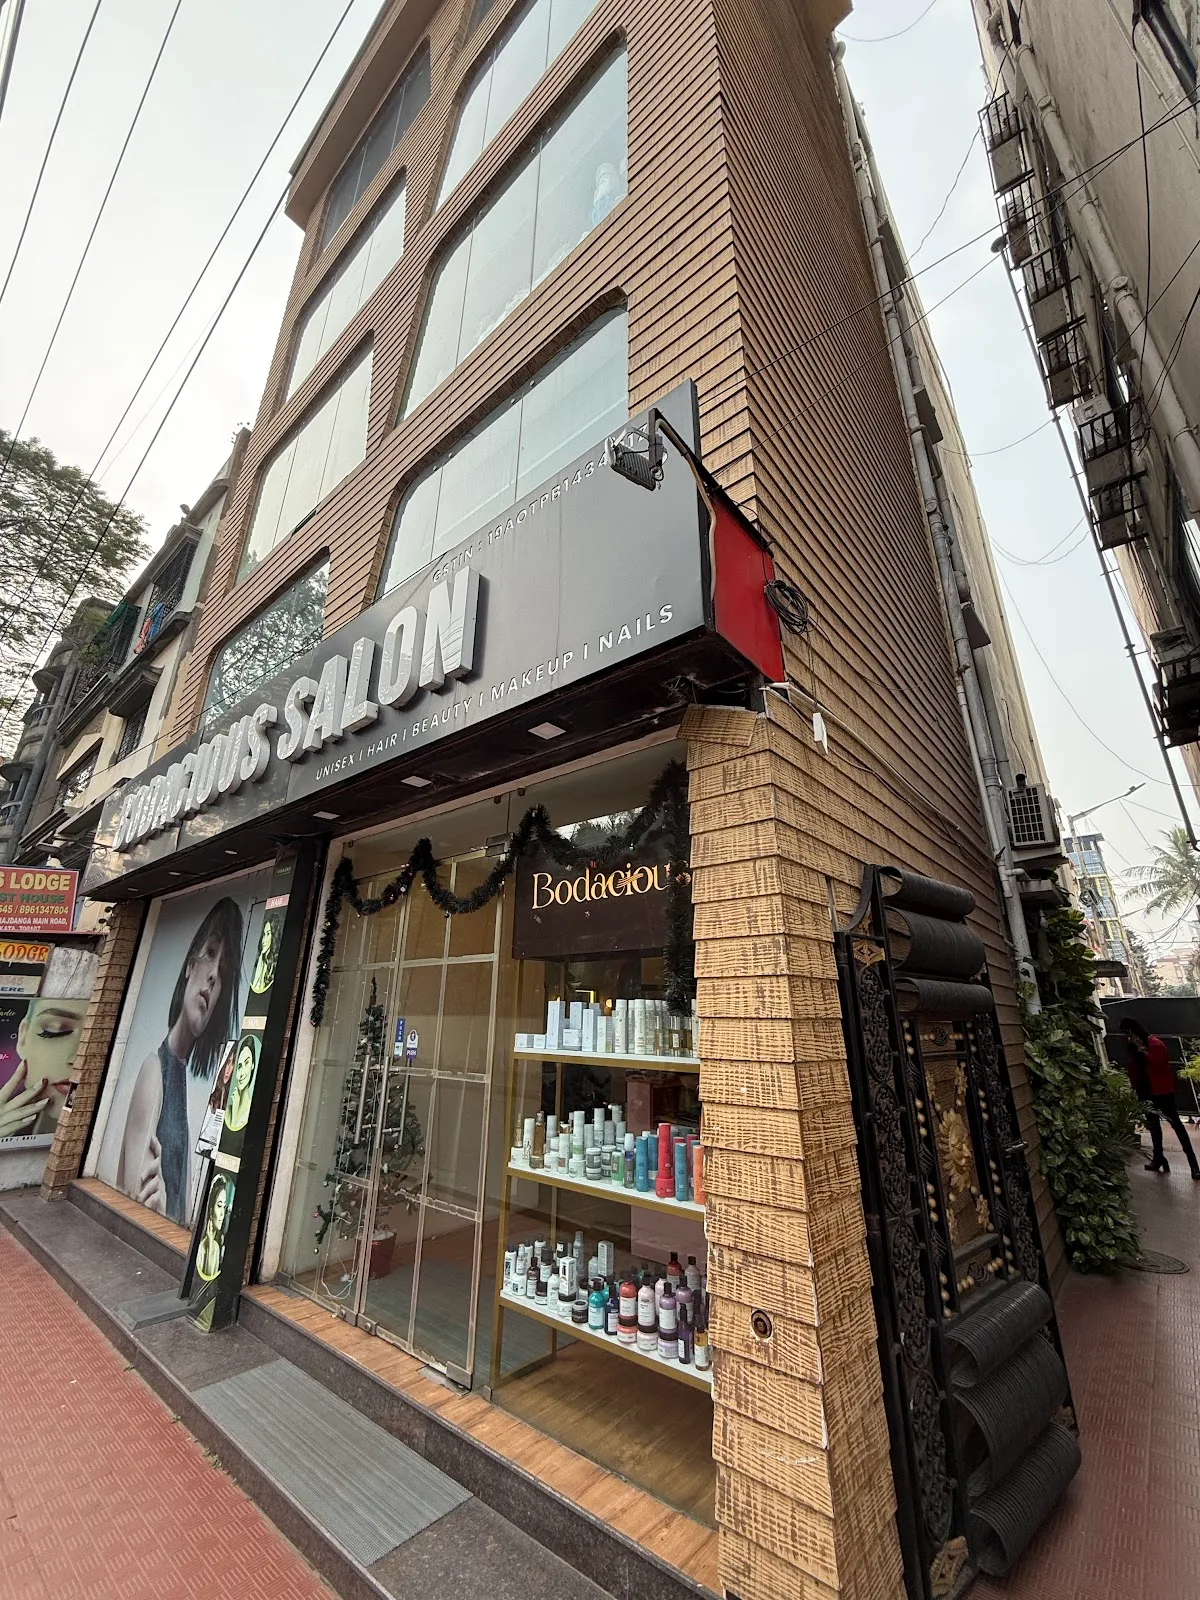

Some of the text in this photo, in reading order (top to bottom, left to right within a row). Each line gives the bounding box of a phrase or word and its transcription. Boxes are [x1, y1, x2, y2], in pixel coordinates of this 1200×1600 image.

[432, 545, 474, 583] GSTIN
[276, 565, 482, 762] SALON
[315, 752, 356, 781] UNISEX
[366, 733, 398, 758] HAIR
[412, 697, 473, 737] BEAUTY
[491, 650, 575, 701] MAKEUP
[598, 603, 674, 653] NAILS
[10, 872, 72, 891] LODGE
[20, 893, 65, 903] HOUSE
[0, 944, 49, 961] ODGE
